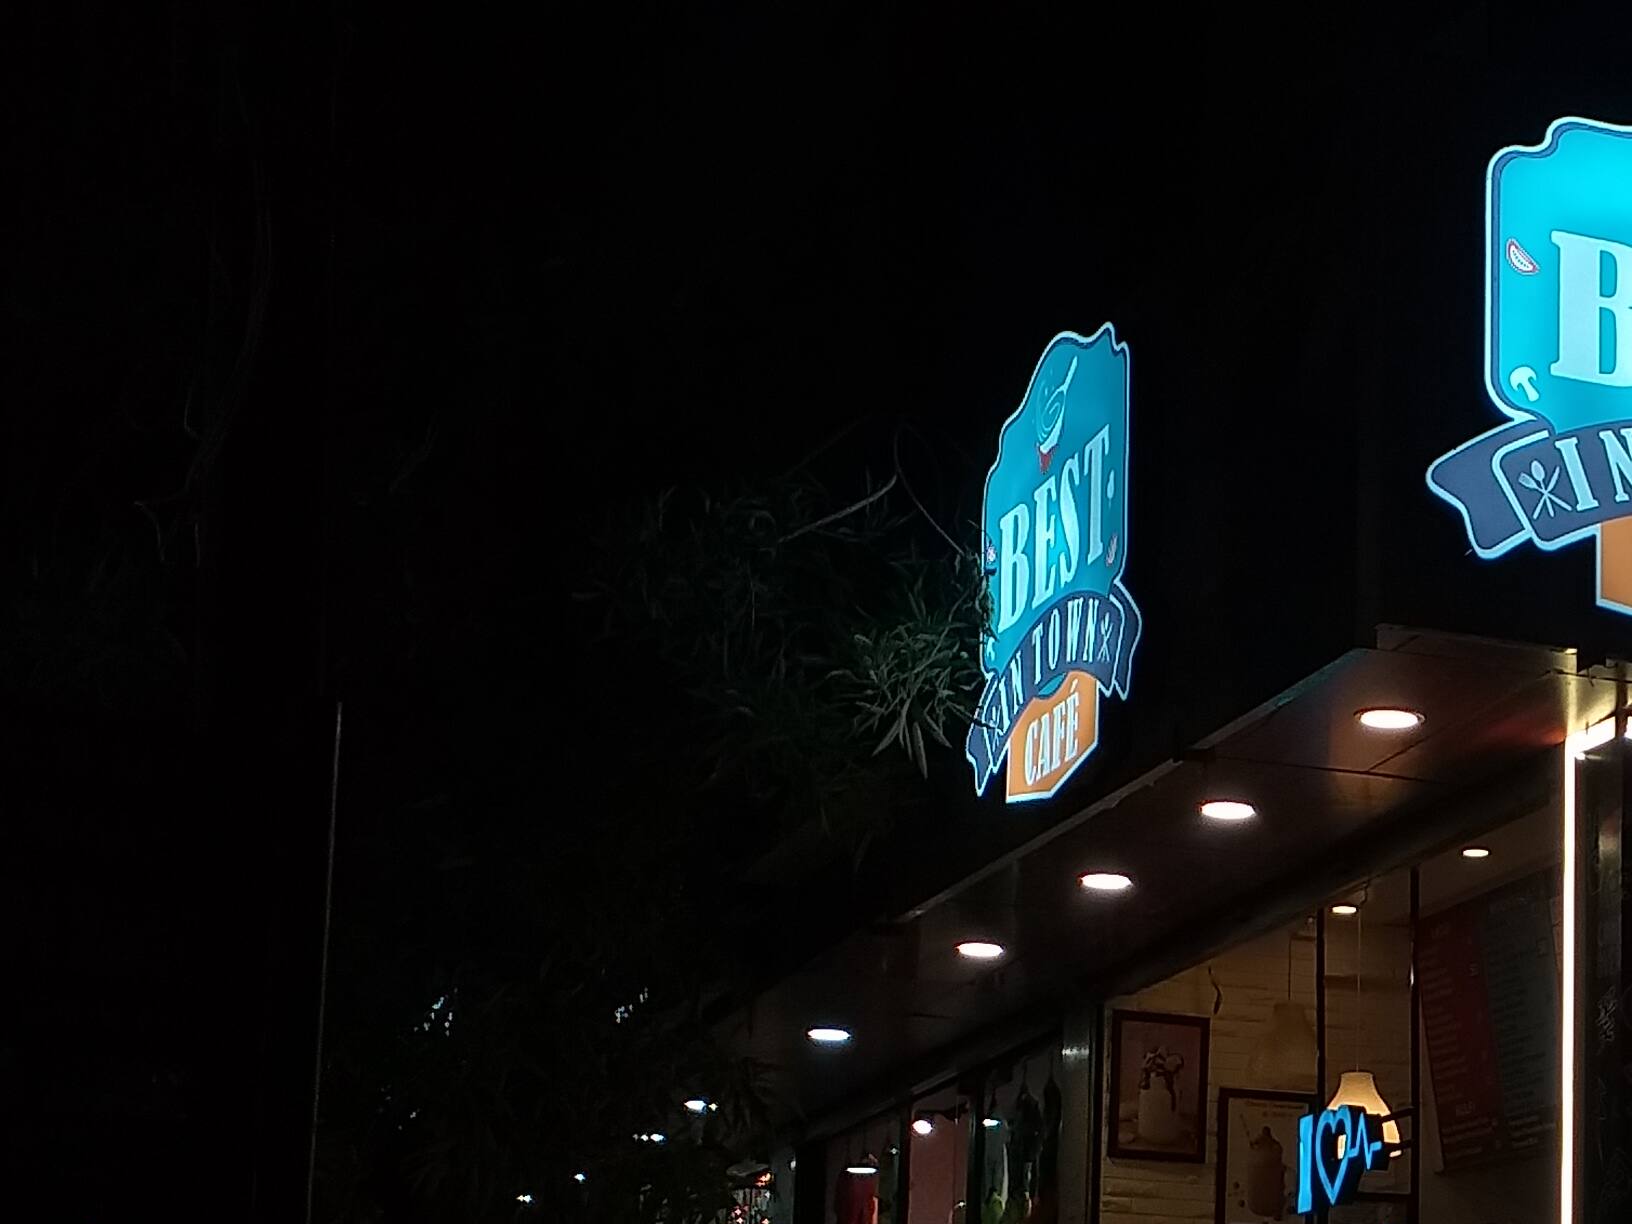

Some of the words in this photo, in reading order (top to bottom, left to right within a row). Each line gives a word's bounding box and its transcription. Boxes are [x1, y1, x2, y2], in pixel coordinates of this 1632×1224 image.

[998, 424, 1110, 634] BEST
[998, 665, 1023, 736] IN
[1032, 597, 1099, 682] TOWN
[1024, 685, 1079, 787] CAFÉ
